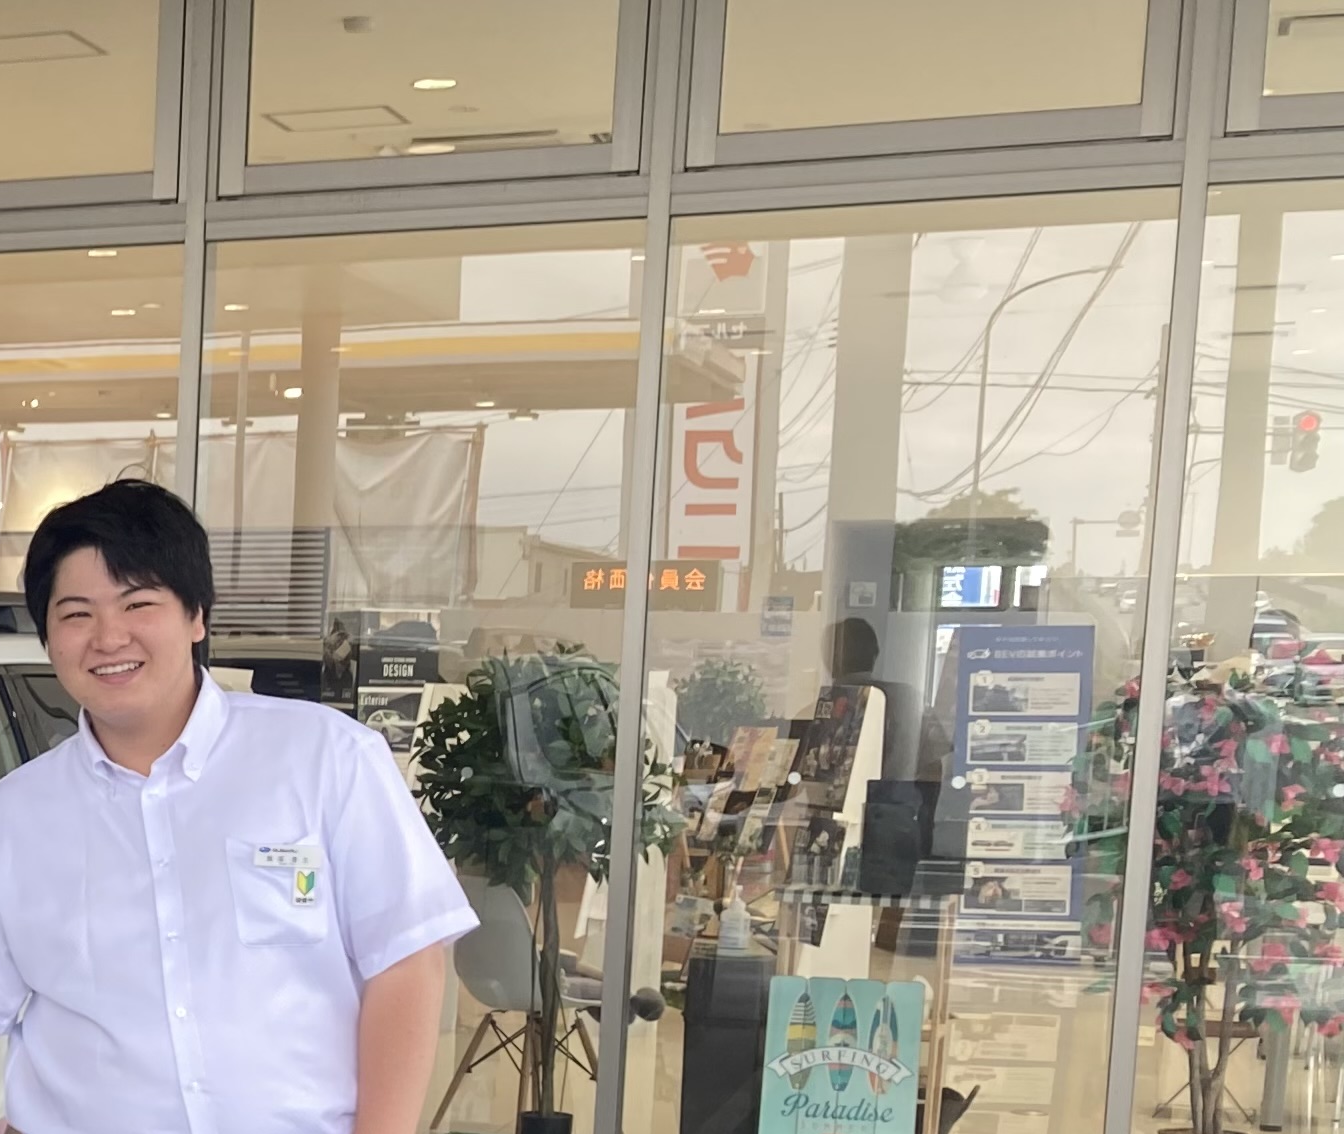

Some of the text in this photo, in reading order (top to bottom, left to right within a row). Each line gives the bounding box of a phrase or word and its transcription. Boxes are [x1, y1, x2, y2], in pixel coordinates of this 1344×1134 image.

[383, 663, 414, 677] DESIGN
[790, 1050, 890, 1075] SURFING
[781, 1092, 895, 1123] Paradise
